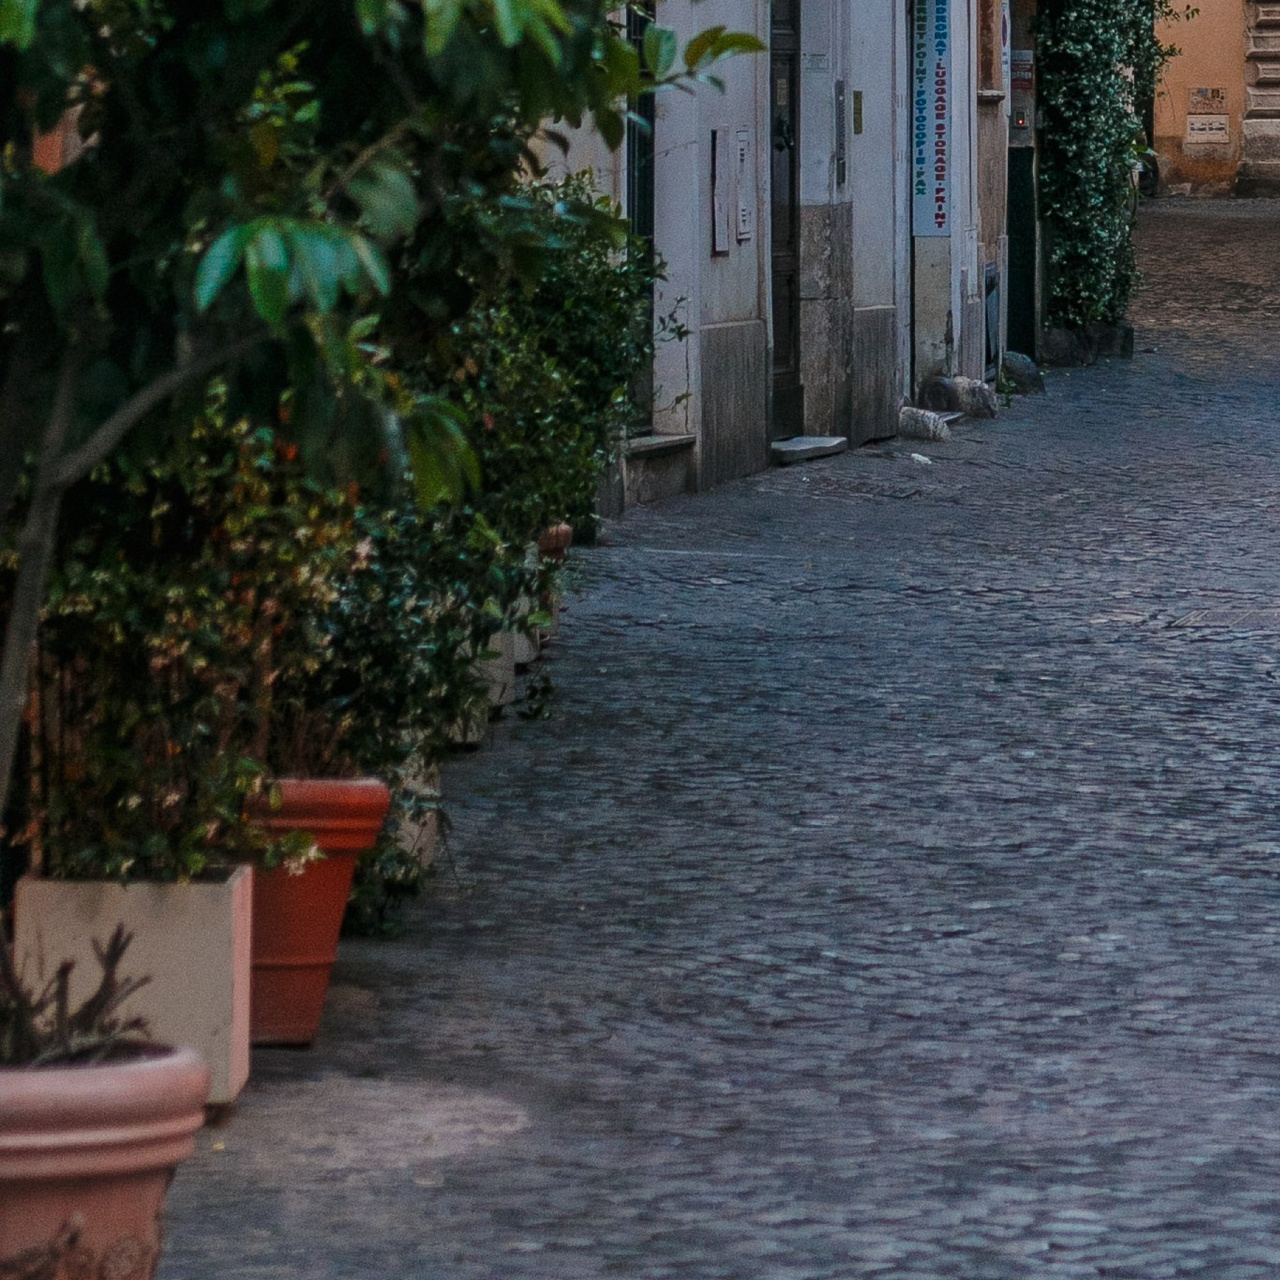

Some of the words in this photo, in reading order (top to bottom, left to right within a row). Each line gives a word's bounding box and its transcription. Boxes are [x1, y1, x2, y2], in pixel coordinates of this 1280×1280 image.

[915, 42, 928, 84] POINT
[934, 62, 947, 120] LUGGAGE
[934, 123, 947, 181] STORAGE
[914, 170, 927, 196] FAX
[934, 187, 947, 229] PRINT
